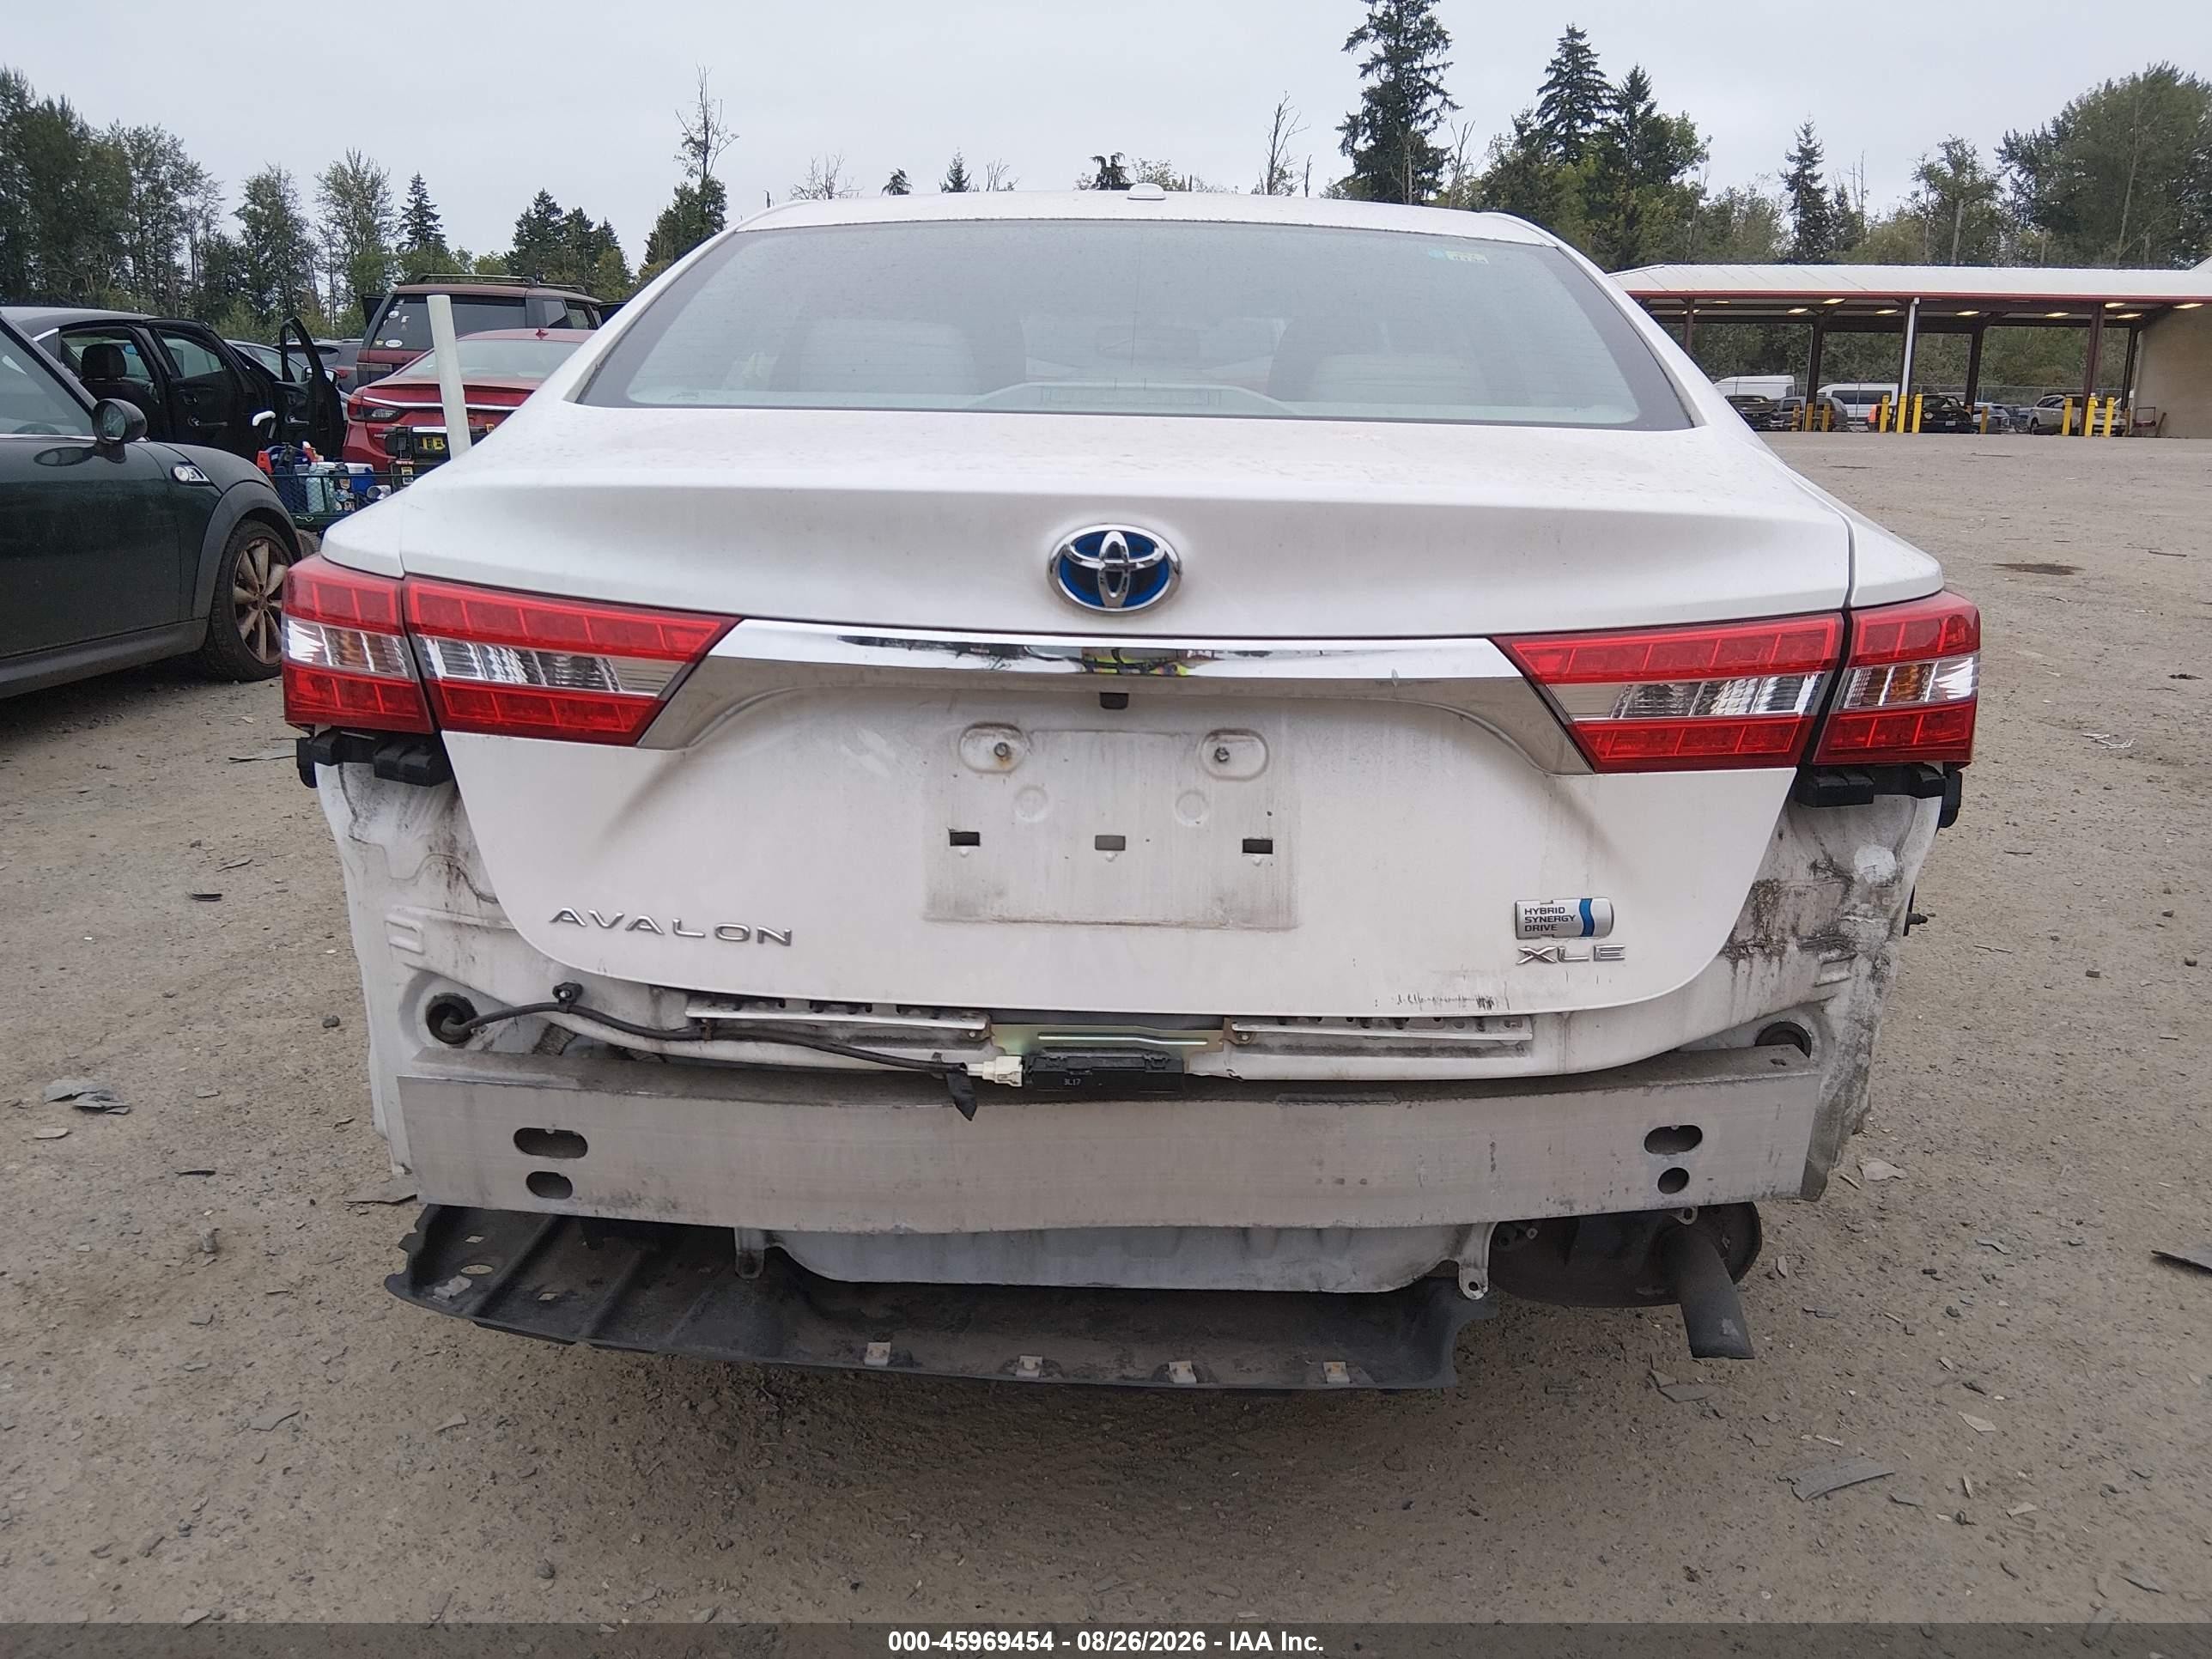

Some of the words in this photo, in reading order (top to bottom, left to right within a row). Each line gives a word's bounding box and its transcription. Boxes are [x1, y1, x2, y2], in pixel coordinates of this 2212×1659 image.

[1524, 907, 1565, 916] HYBRID
[1524, 915, 1576, 924] SYNERGY
[549, 907, 792, 946] AVALON
[1524, 923, 1559, 933] DRIVE
[1516, 945, 1626, 965] XLE
